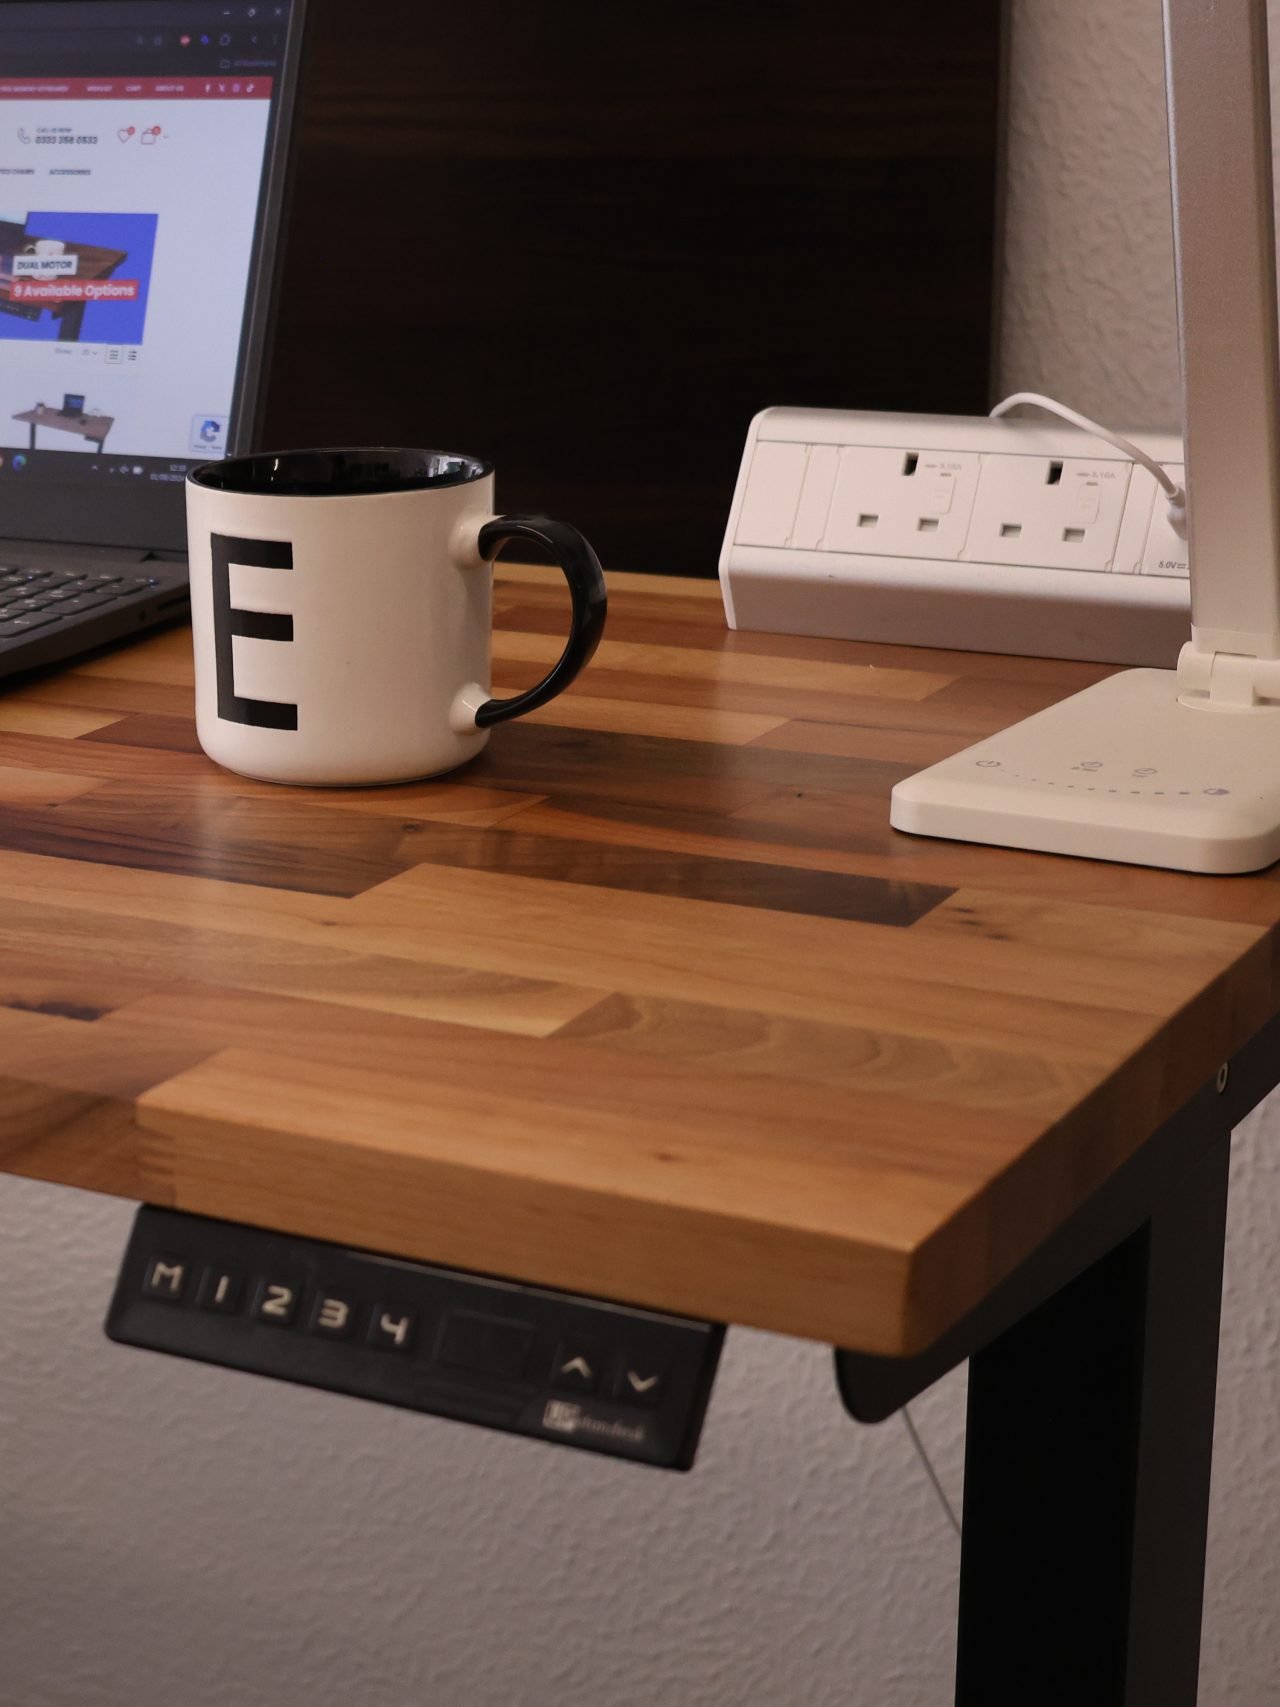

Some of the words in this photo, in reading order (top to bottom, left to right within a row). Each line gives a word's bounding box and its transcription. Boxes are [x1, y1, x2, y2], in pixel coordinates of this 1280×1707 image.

[17, 261, 39, 270] DUAL
[41, 261, 73, 270] MOTOR
[14, 286, 22, 298] 9
[24, 284, 83, 297] Available
[85, 284, 134, 300] Options
[211, 532, 298, 731] E
[151, 1261, 183, 1291] M
[214, 1275, 229, 1303] 1
[261, 1285, 293, 1316] 2
[318, 1298, 349, 1329] 3
[380, 1313, 409, 1345] 4
